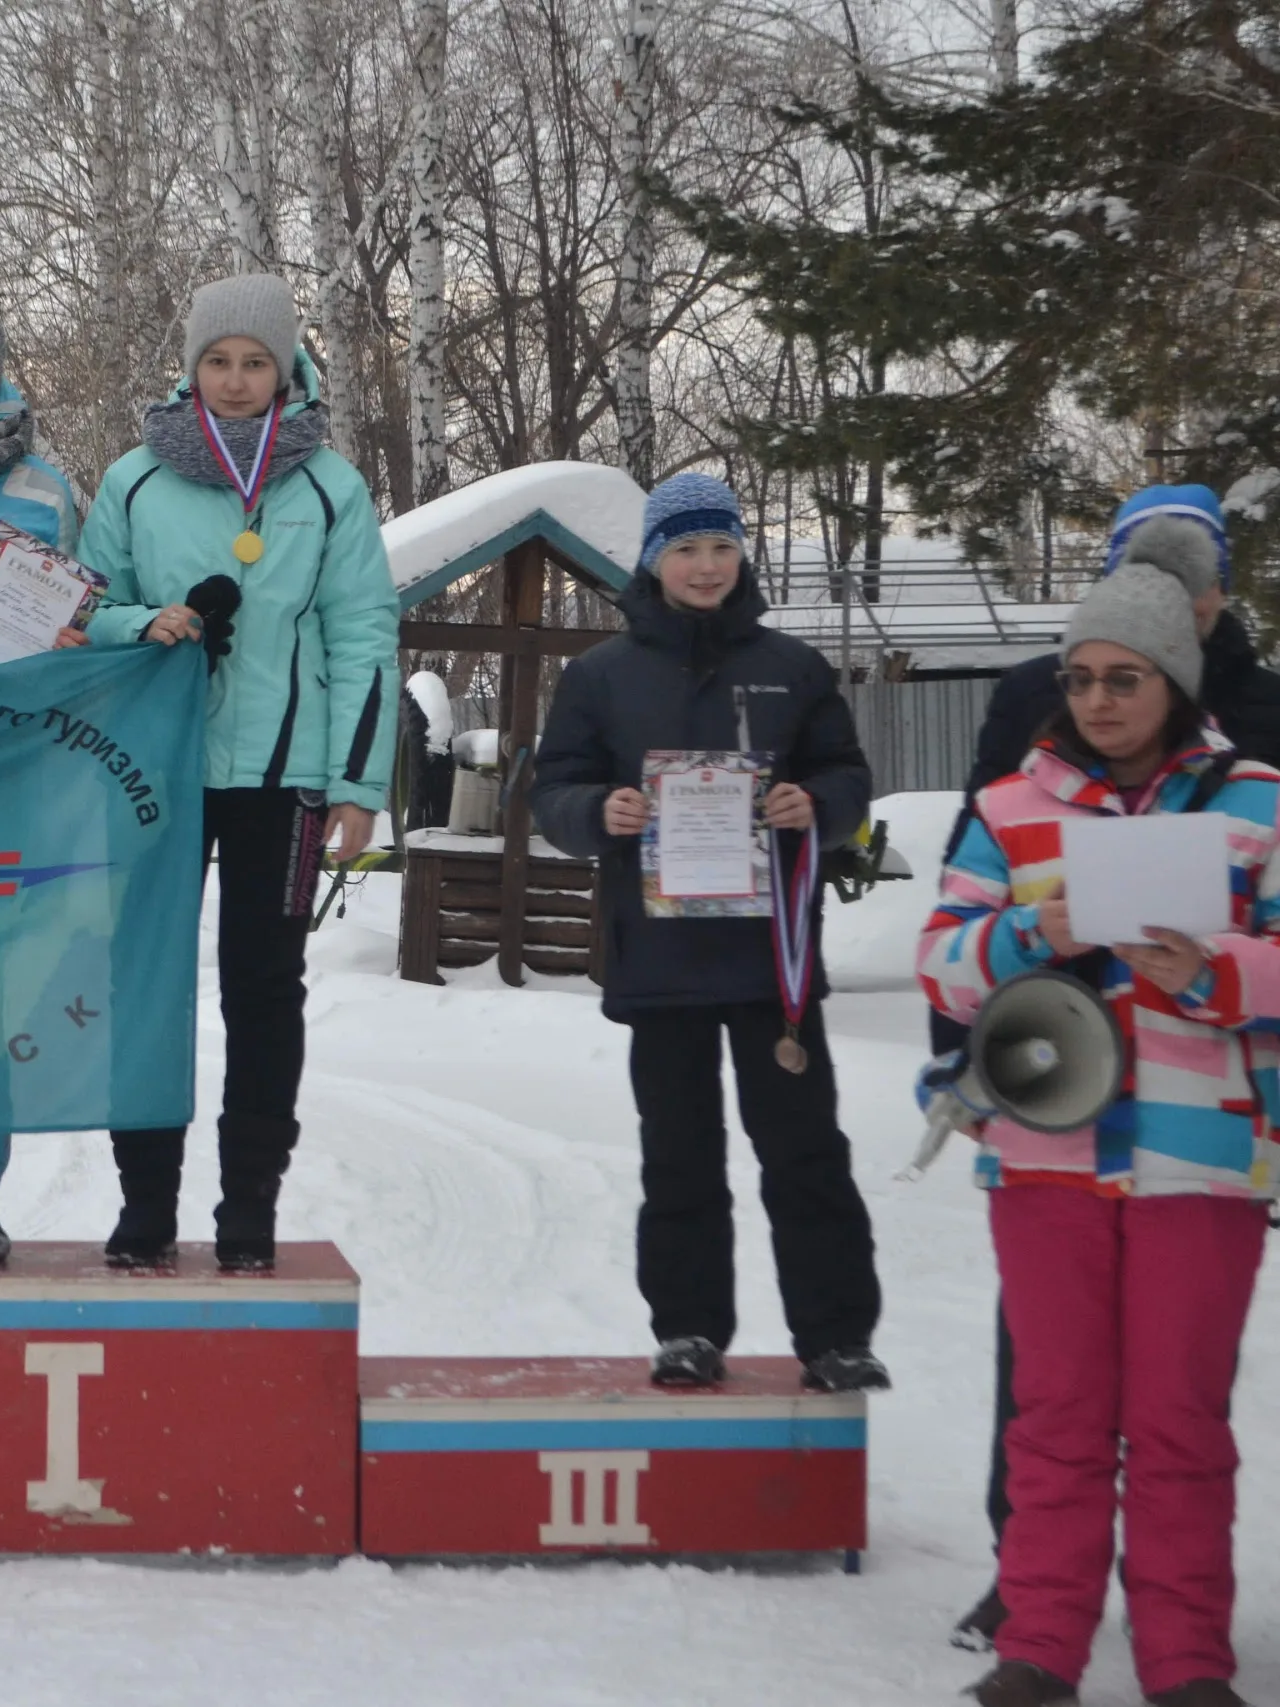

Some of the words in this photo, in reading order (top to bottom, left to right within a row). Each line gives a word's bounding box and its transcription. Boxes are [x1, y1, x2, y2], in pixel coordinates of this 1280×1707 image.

[8, 557, 73, 598] ГРАМОТА
[43, 709, 160, 827] туризма
[669, 785, 742, 796] ГРАМОТА
[25, 1343, 105, 1514] I
[538, 1450, 650, 1545] III
